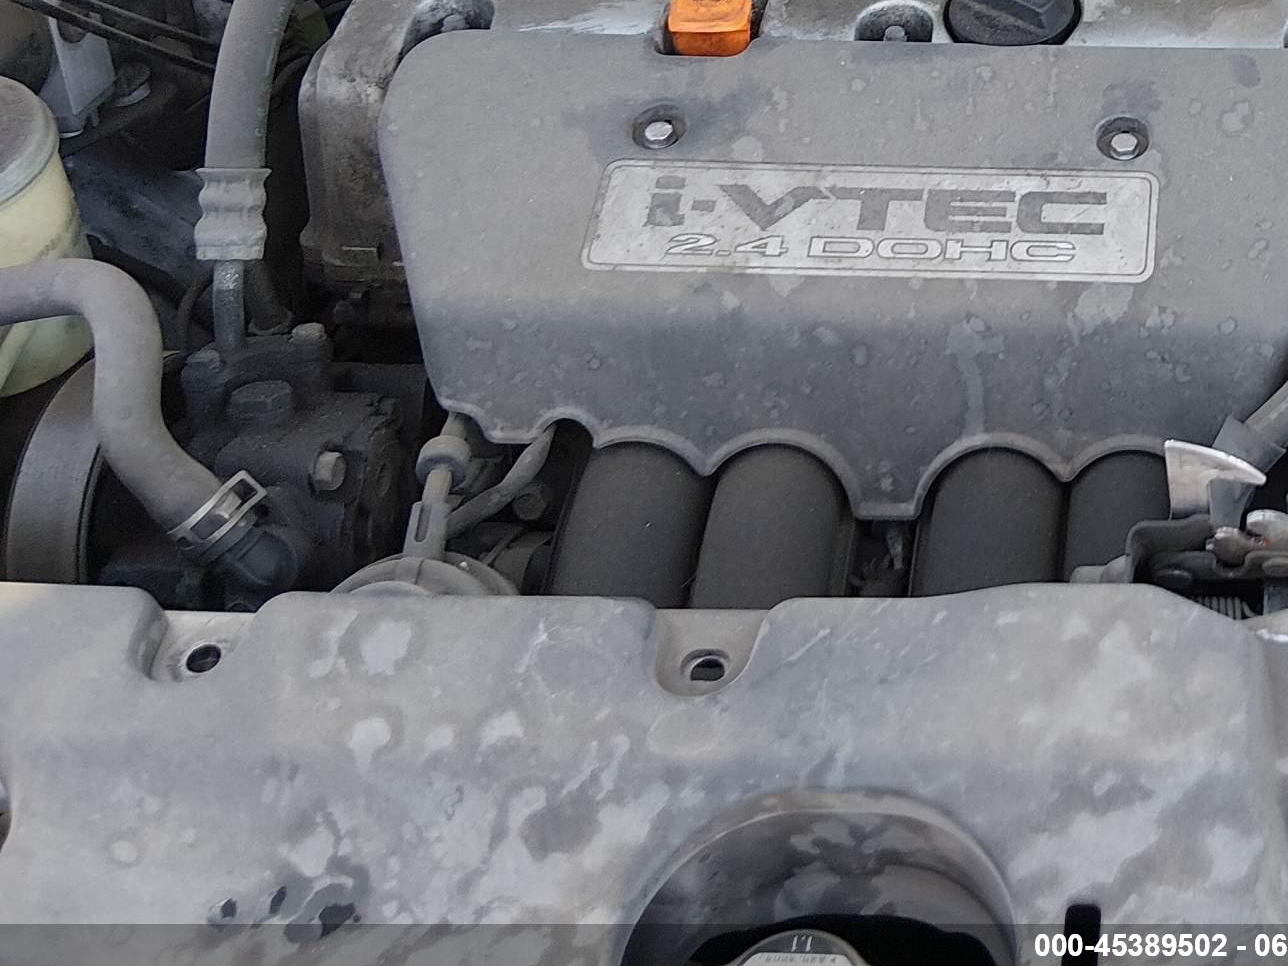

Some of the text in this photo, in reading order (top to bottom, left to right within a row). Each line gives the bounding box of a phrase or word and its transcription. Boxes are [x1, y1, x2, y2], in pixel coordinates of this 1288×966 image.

[643, 174, 1108, 235] i-VTEC
[664, 233, 1078, 263] 2.4 DOHC
